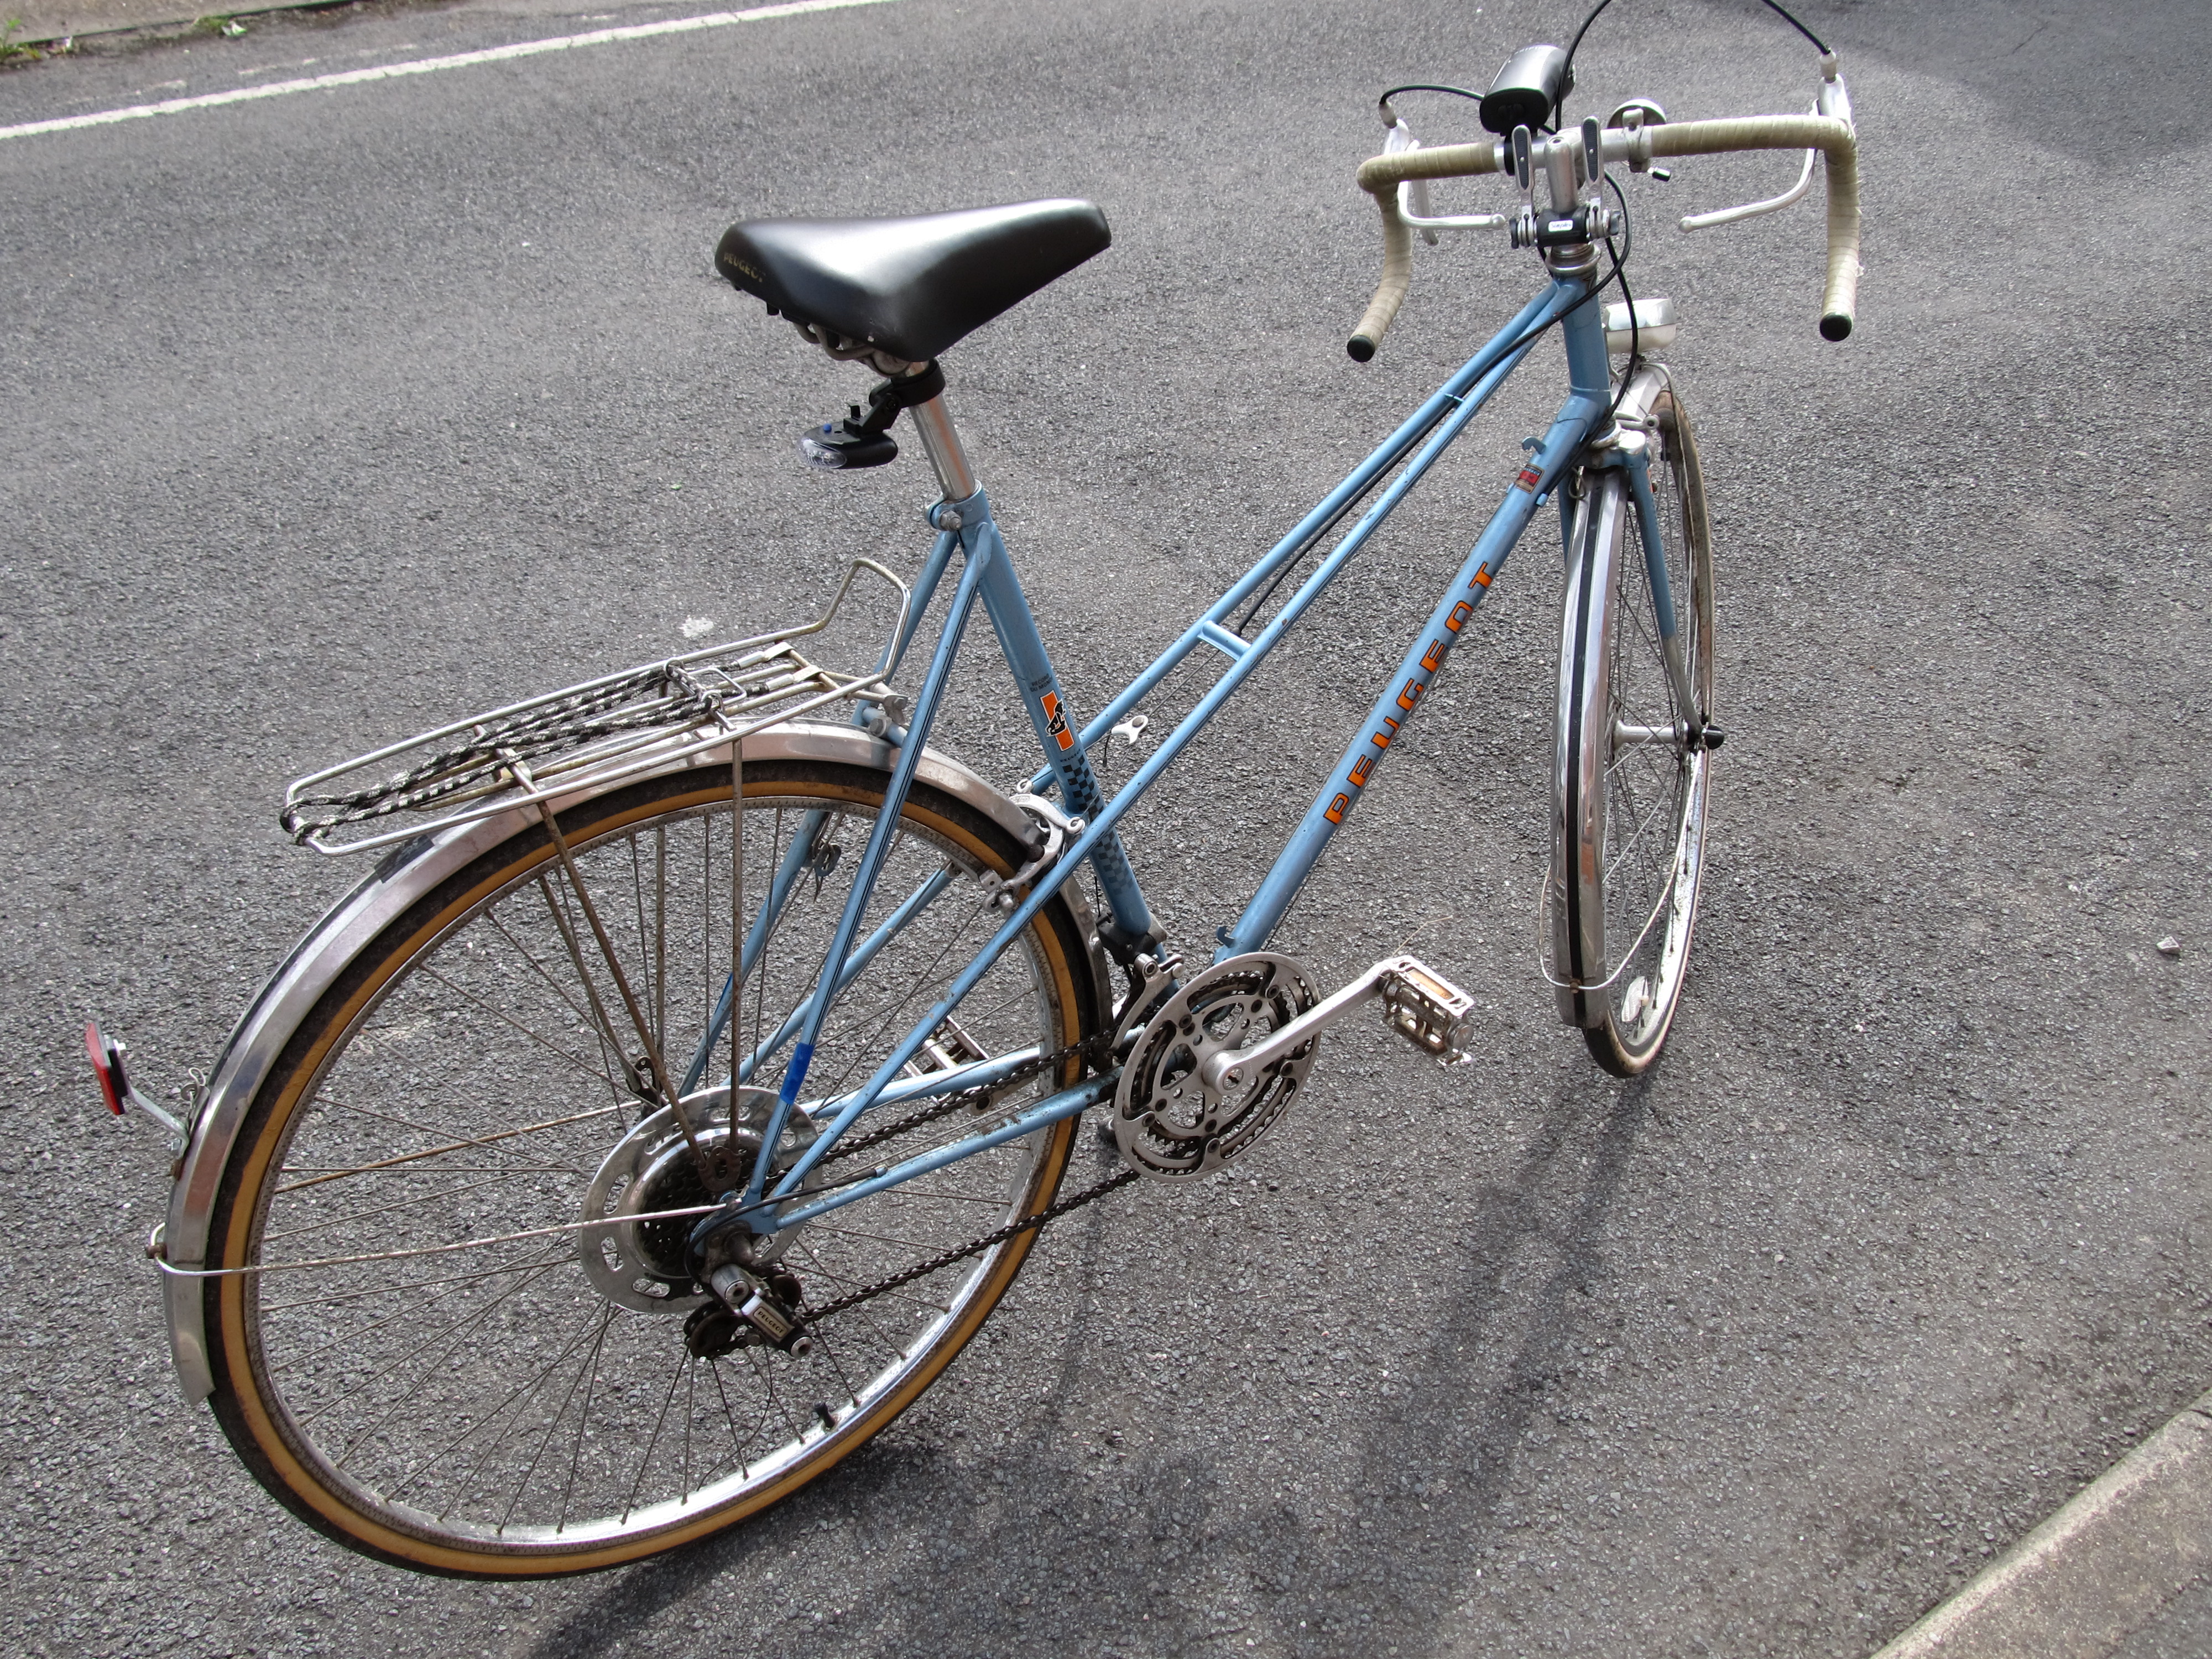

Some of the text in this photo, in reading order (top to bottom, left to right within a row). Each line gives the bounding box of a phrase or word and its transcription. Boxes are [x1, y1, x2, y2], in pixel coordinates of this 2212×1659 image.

[1031, 673, 1050, 686] RECORD
[1039, 675, 1053, 690] MOND
[1323, 561, 1493, 825] PEUGEOT
[758, 1311, 784, 1333] PEUGEOT
